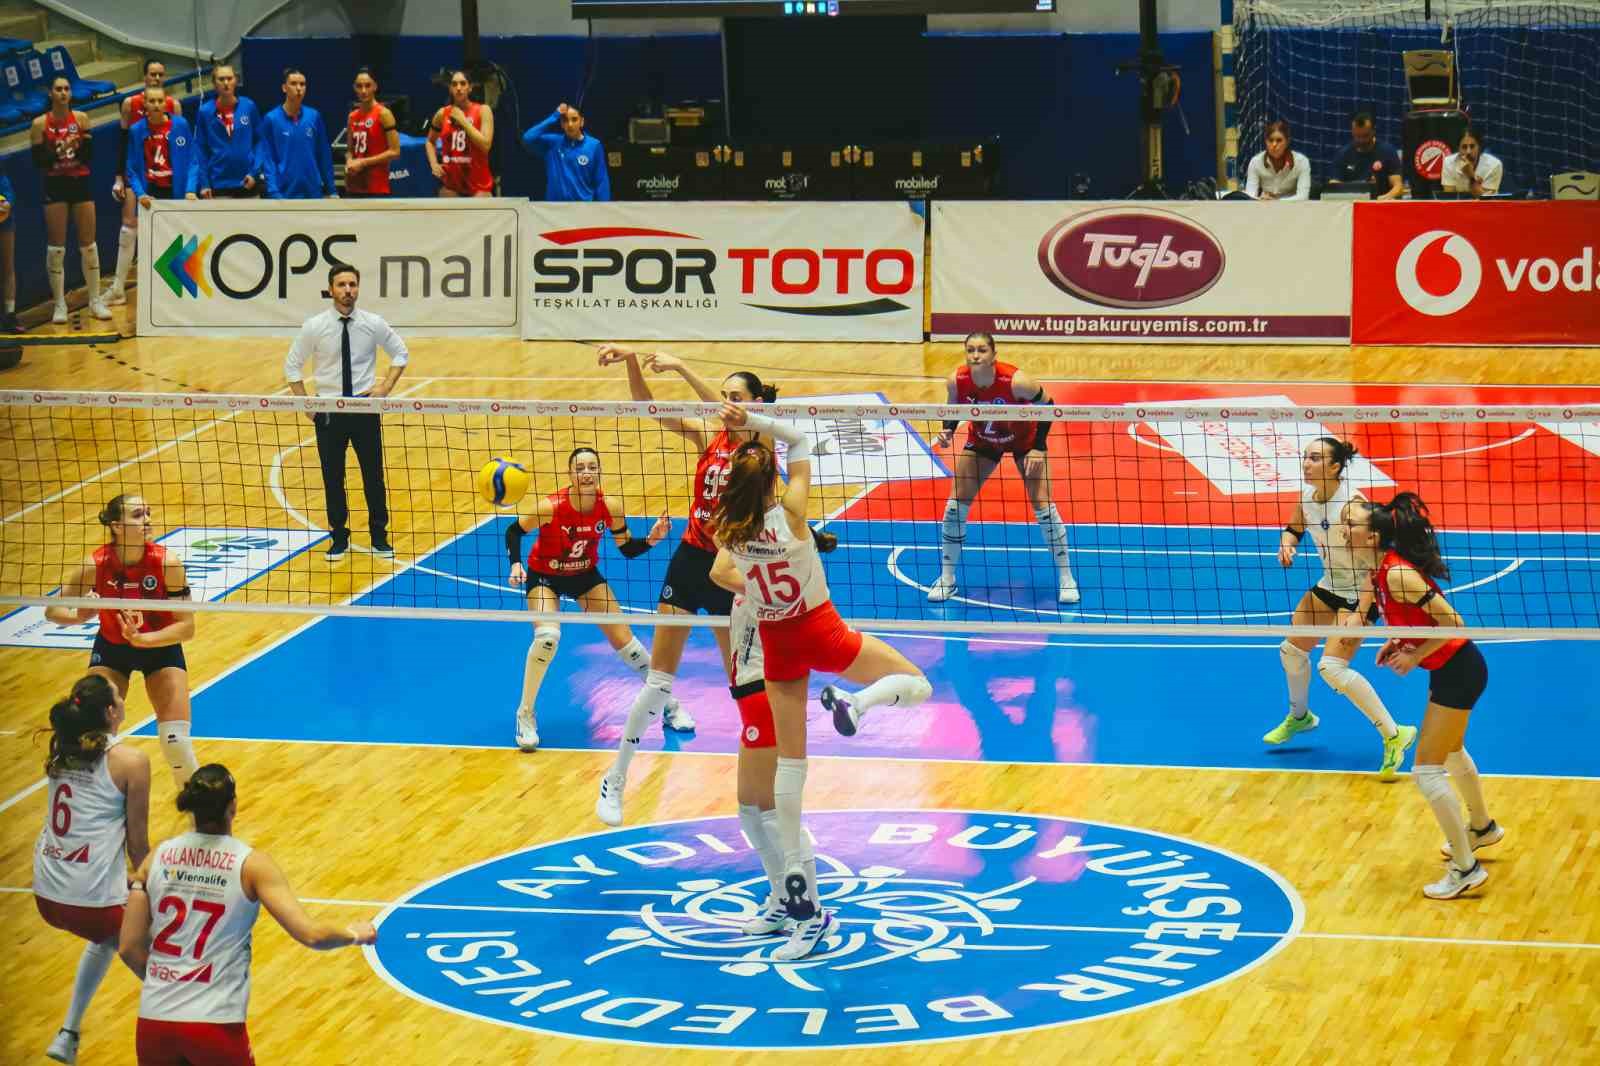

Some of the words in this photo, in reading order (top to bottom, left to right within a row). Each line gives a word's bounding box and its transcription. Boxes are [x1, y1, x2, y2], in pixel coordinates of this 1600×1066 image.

[353, 131, 368, 153] 73
[452, 130, 466, 151] 18
[154, 145, 166, 165] 4
[636, 176, 680, 190] mobiled
[895, 175, 938, 190] mobiled
[379, 234, 512, 298] mall
[533, 248, 716, 294] SPOR
[727, 248, 914, 294] TOTO
[1495, 246, 1600, 292] vod
[534, 297, 611, 310] TEŞKİLAT
[617, 297, 719, 310] BAŞKANLIĞI
[994, 316, 1268, 335] www.tugbakuruyemis.com.tr
[746, 560, 801, 606] 15
[52, 783, 73, 838] 6
[176, 870, 227, 887] Viennalife
[867, 822, 1243, 1002] BÜYÜKŞEHİR
[153, 895, 226, 961] 27
[149, 963, 180, 983] aras
[405, 930, 1014, 1035] BELEDİYESİ
